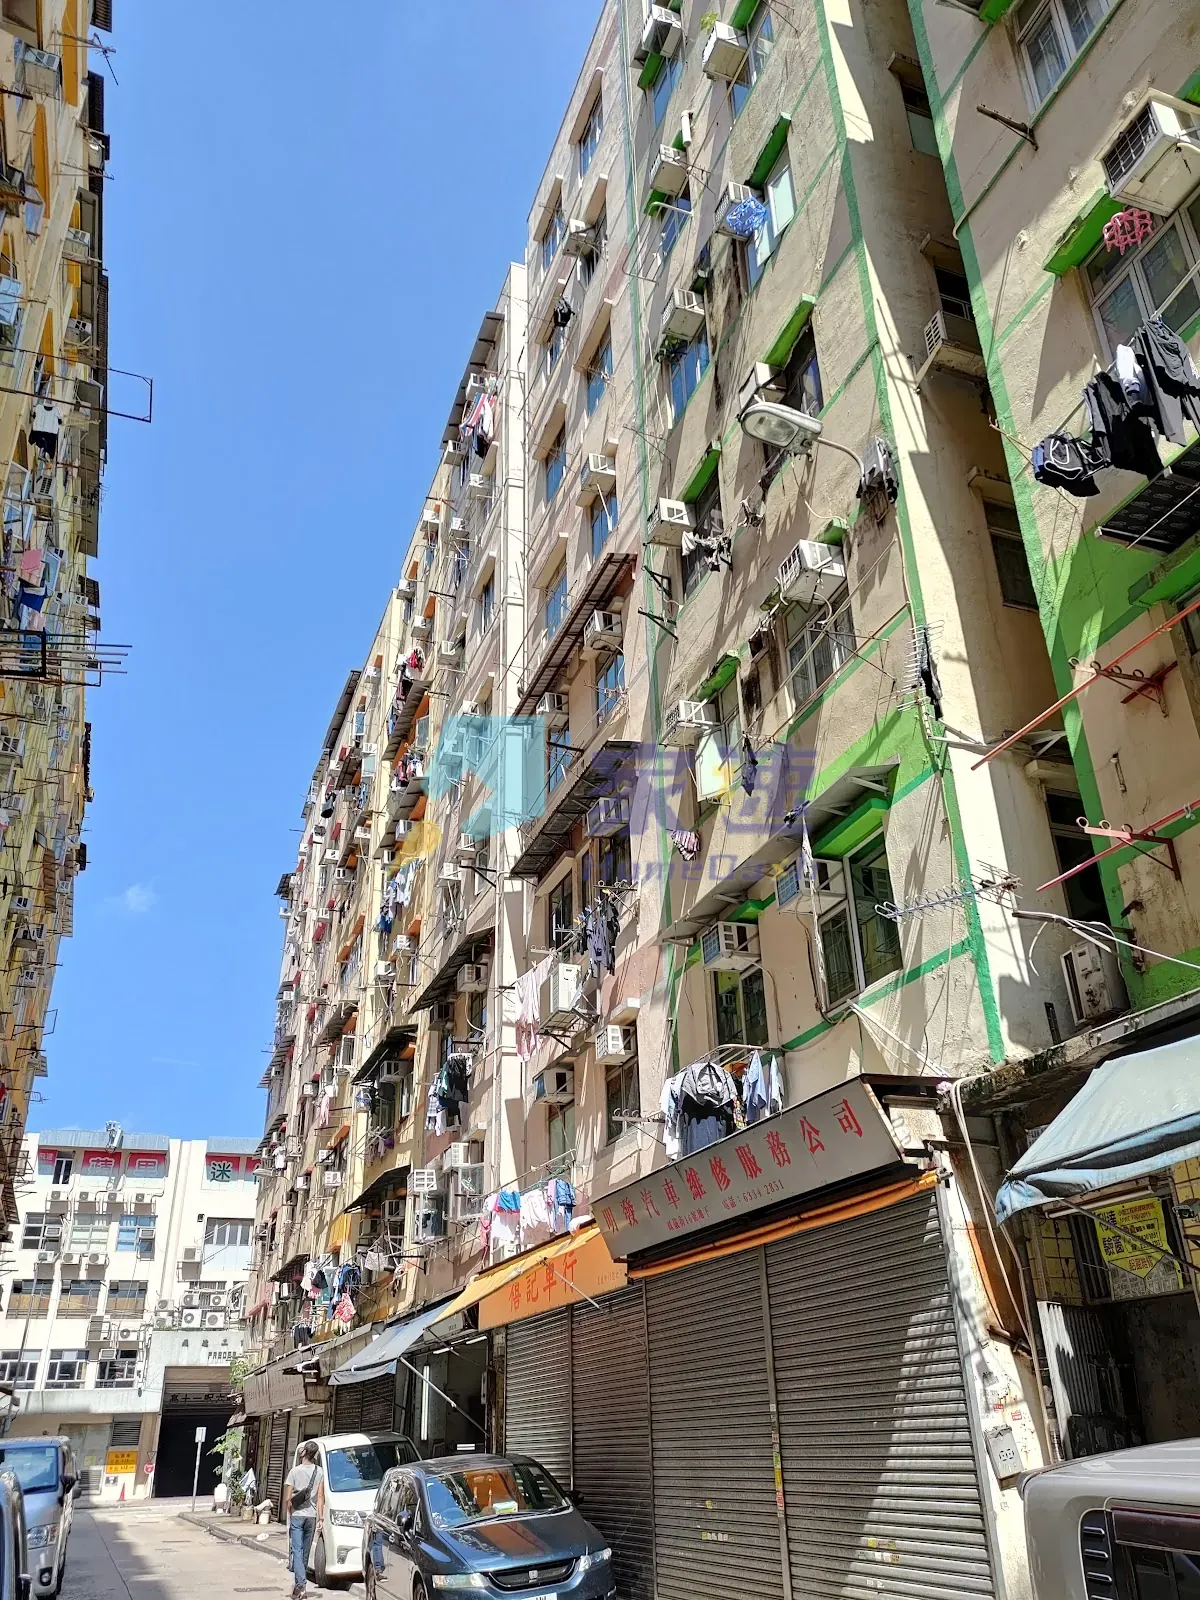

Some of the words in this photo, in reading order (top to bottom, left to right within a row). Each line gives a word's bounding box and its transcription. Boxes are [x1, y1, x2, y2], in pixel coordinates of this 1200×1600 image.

[602, 1098, 865, 1234] 明發汽車維修服務公司
